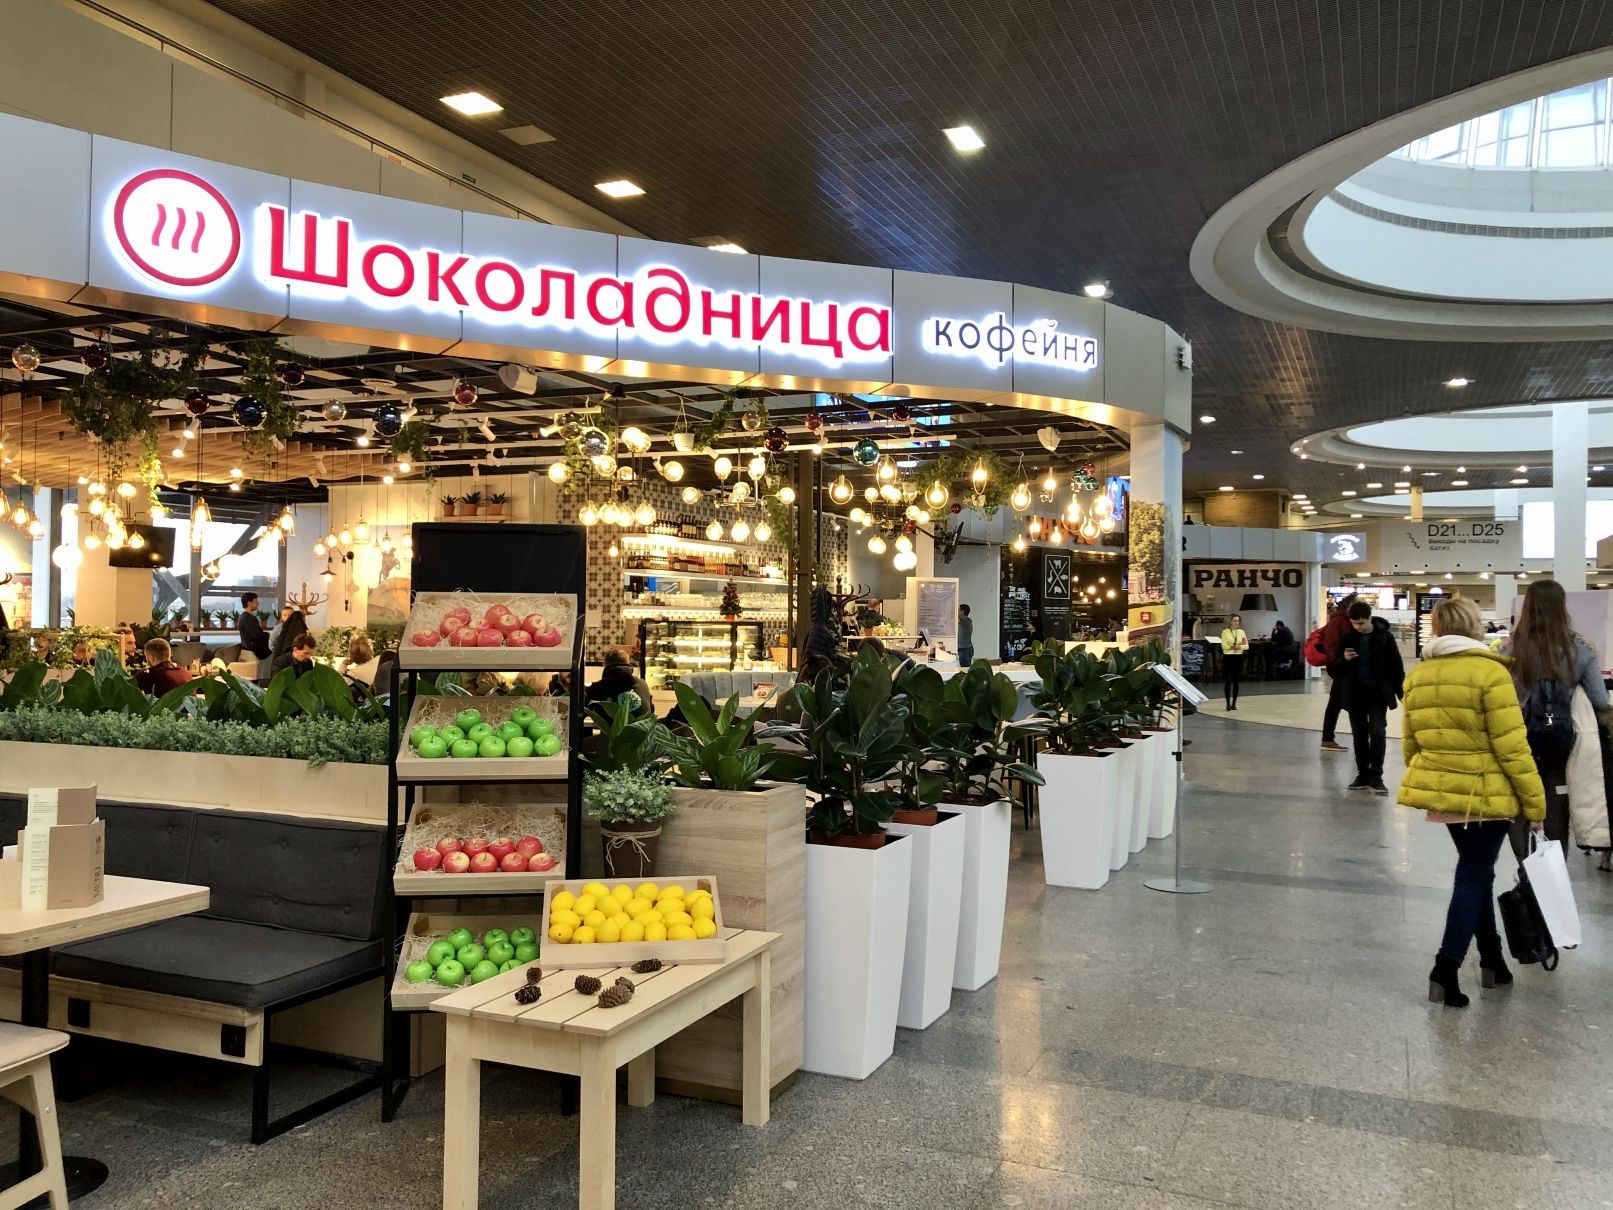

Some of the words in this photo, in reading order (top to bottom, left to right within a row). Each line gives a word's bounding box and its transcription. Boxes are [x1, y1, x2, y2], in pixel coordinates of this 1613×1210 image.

[269, 206, 891, 358] Шоколадница
[935, 314, 1096, 365] кофейня
[1193, 568, 1303, 588] РАНЧО
